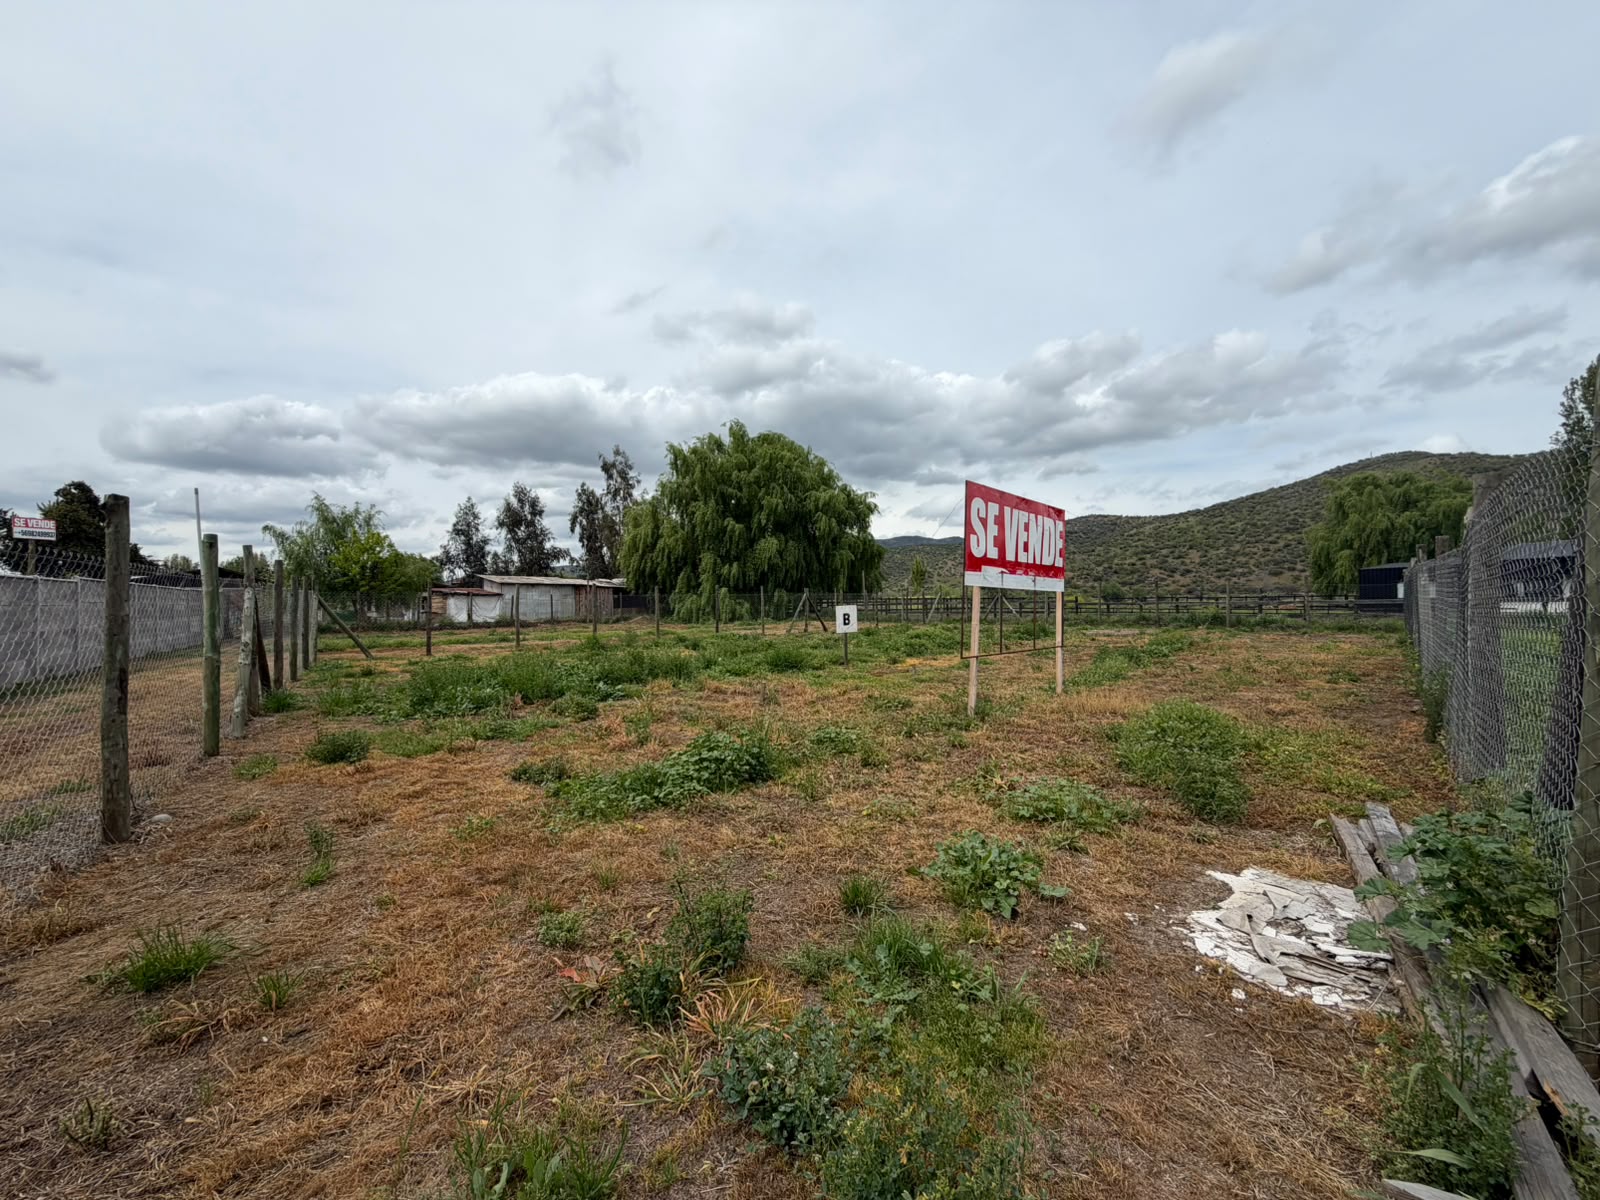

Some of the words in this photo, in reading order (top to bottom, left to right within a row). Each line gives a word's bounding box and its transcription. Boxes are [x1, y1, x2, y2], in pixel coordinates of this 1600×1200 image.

[14, 518, 26, 527] SE
[27, 519, 56, 528] VENDE
[970, 497, 999, 559] SE
[1004, 506, 1063, 567] VENDE
[843, 613, 850, 626] B
